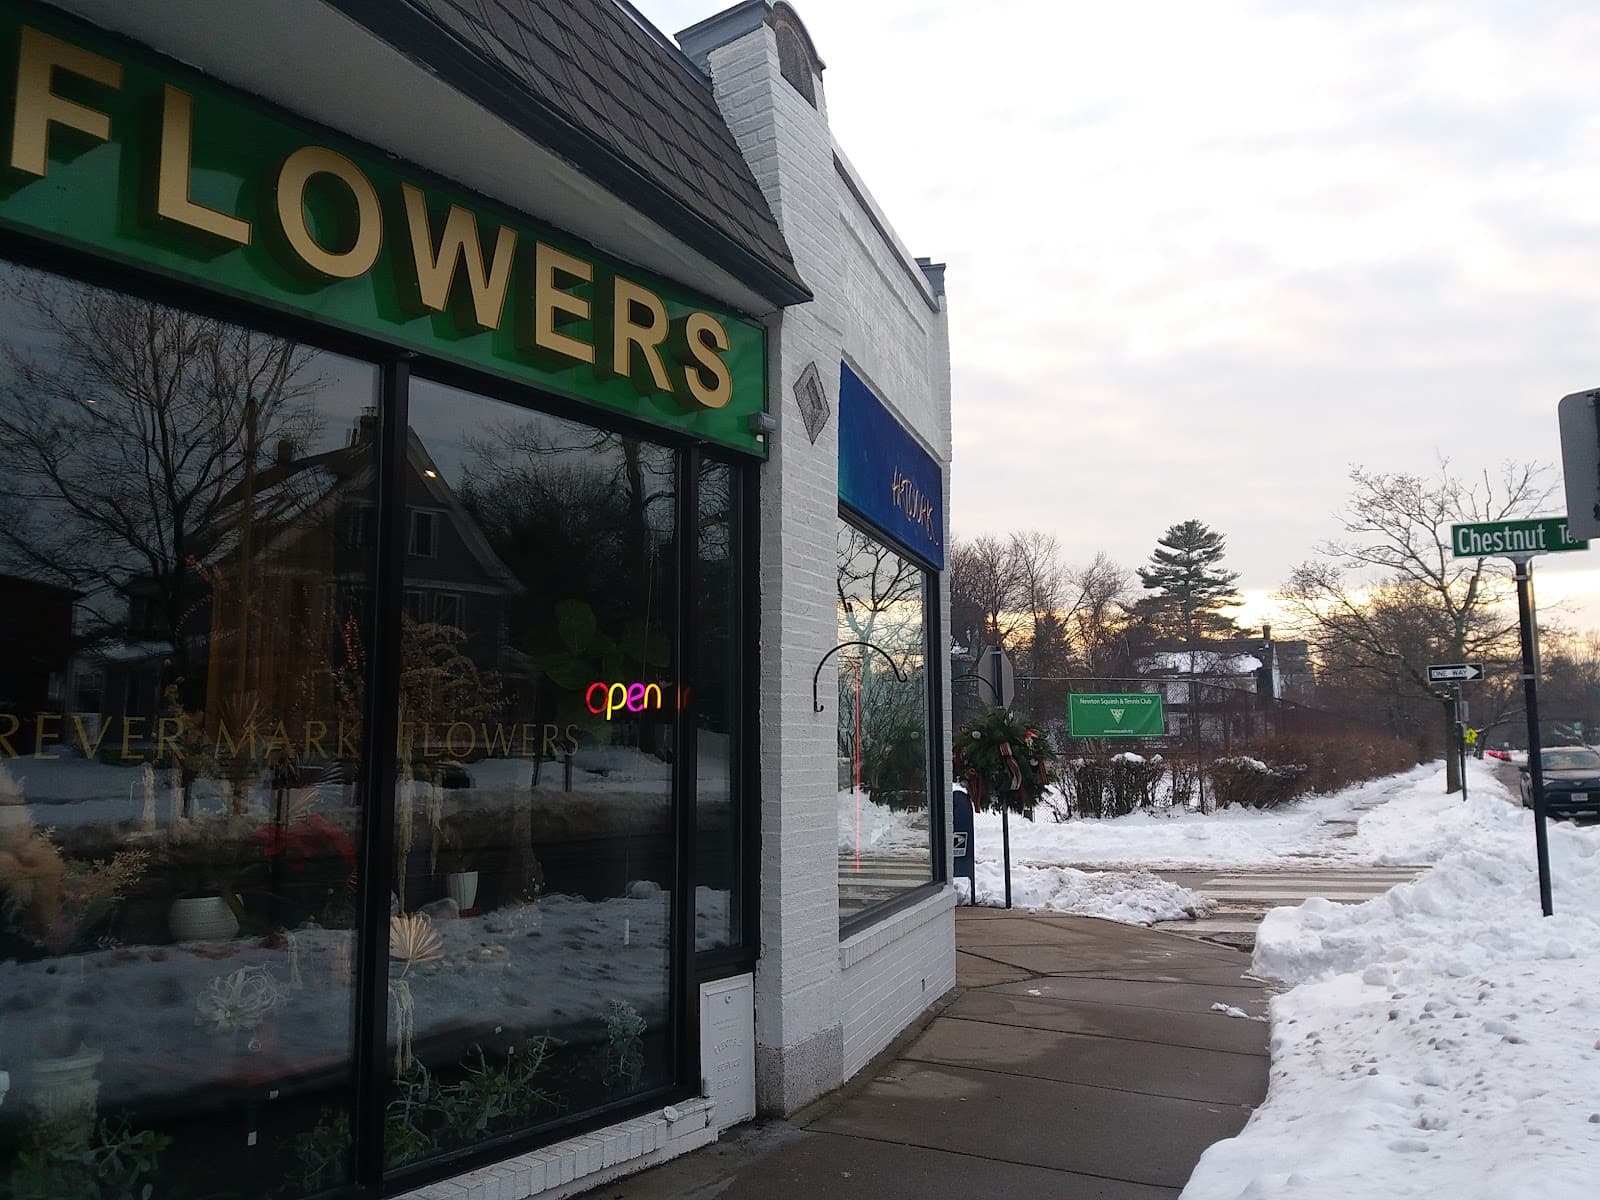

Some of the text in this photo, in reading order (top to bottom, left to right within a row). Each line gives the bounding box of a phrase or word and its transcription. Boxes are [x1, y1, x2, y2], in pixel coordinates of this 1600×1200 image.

[10, 25, 733, 409] FLOWERS
[1458, 523, 1547, 553] Chestnut
[1432, 669, 1467, 678] ONE WAY
[213, 719, 361, 760] MARK
[397, 721, 580, 759] FLOWERS
